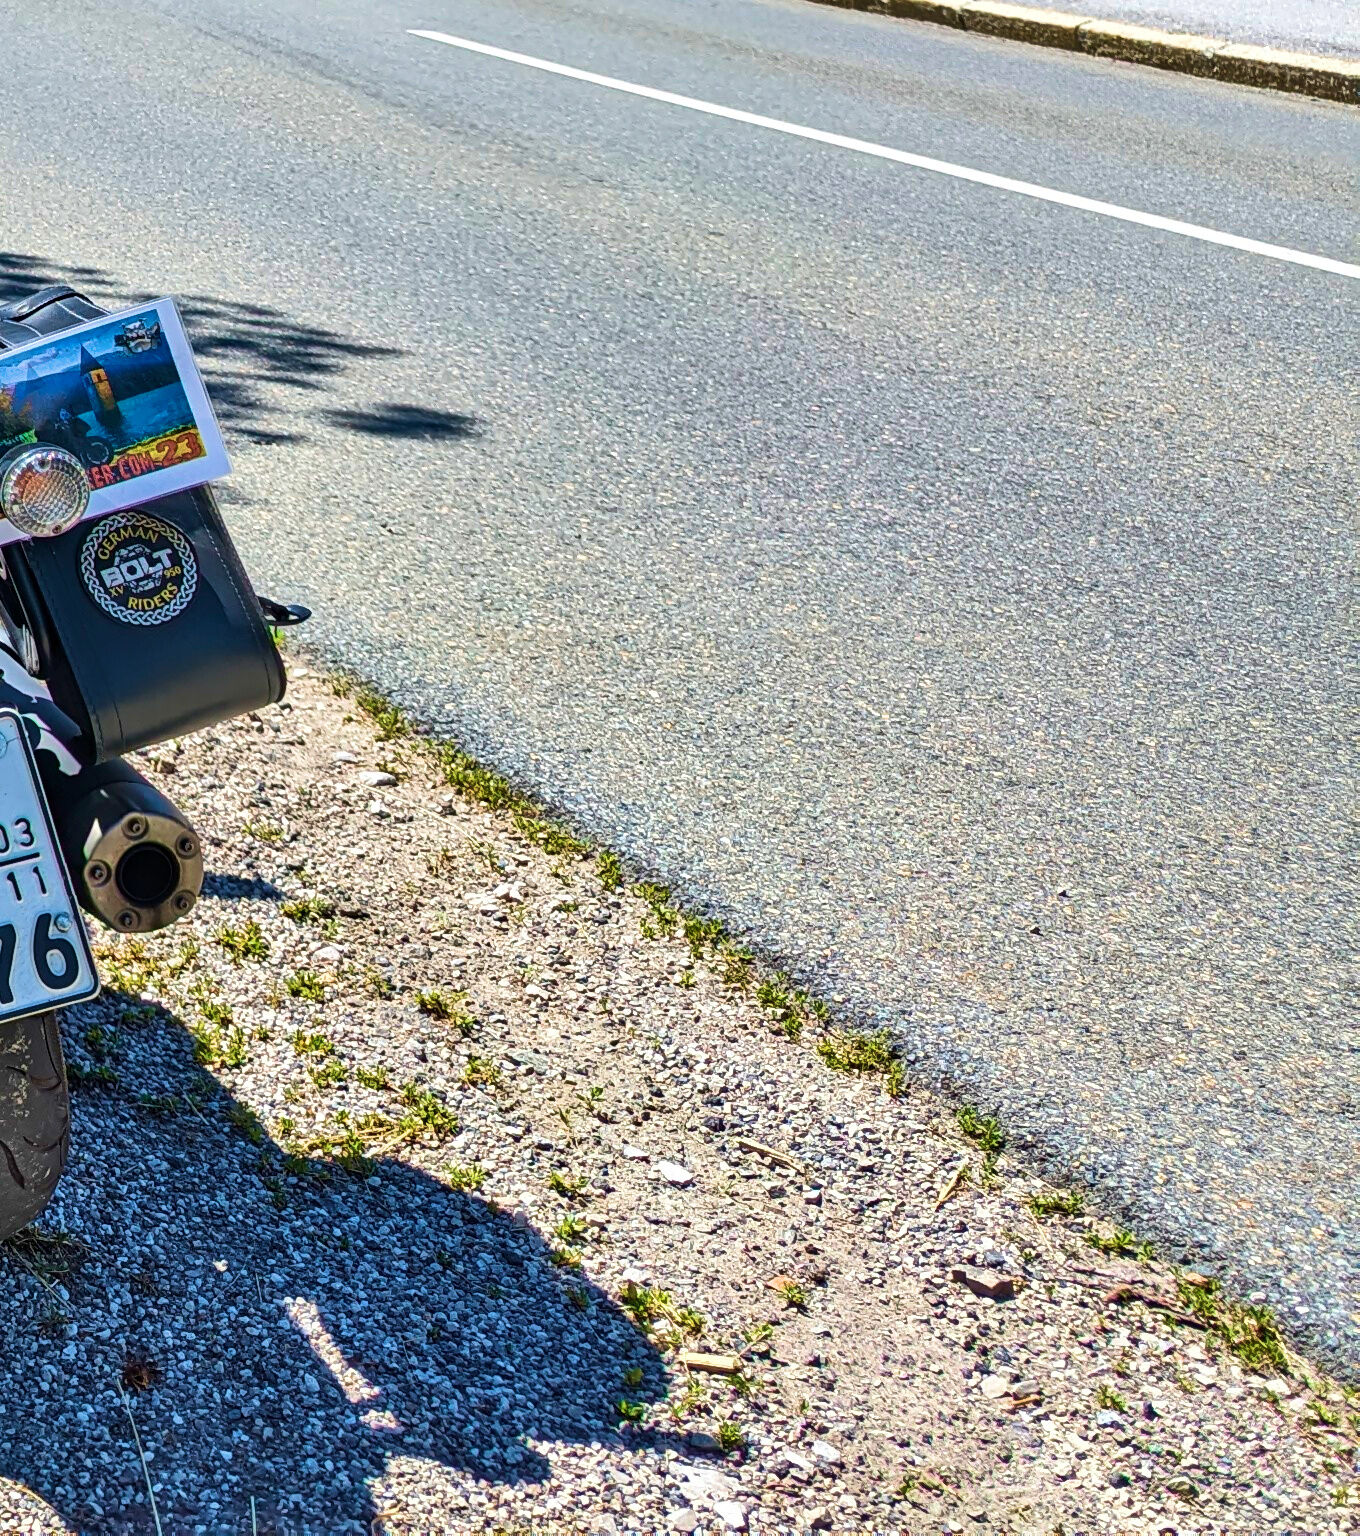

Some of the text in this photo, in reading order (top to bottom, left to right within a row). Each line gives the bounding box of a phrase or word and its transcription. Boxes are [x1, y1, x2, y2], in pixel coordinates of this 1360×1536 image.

[97, 526, 159, 560] GERMAN
[100, 548, 173, 588] BOLT
[108, 566, 182, 598] XV 950
[127, 582, 179, 611] RIDERS
[6, 866, 48, 901] 11
